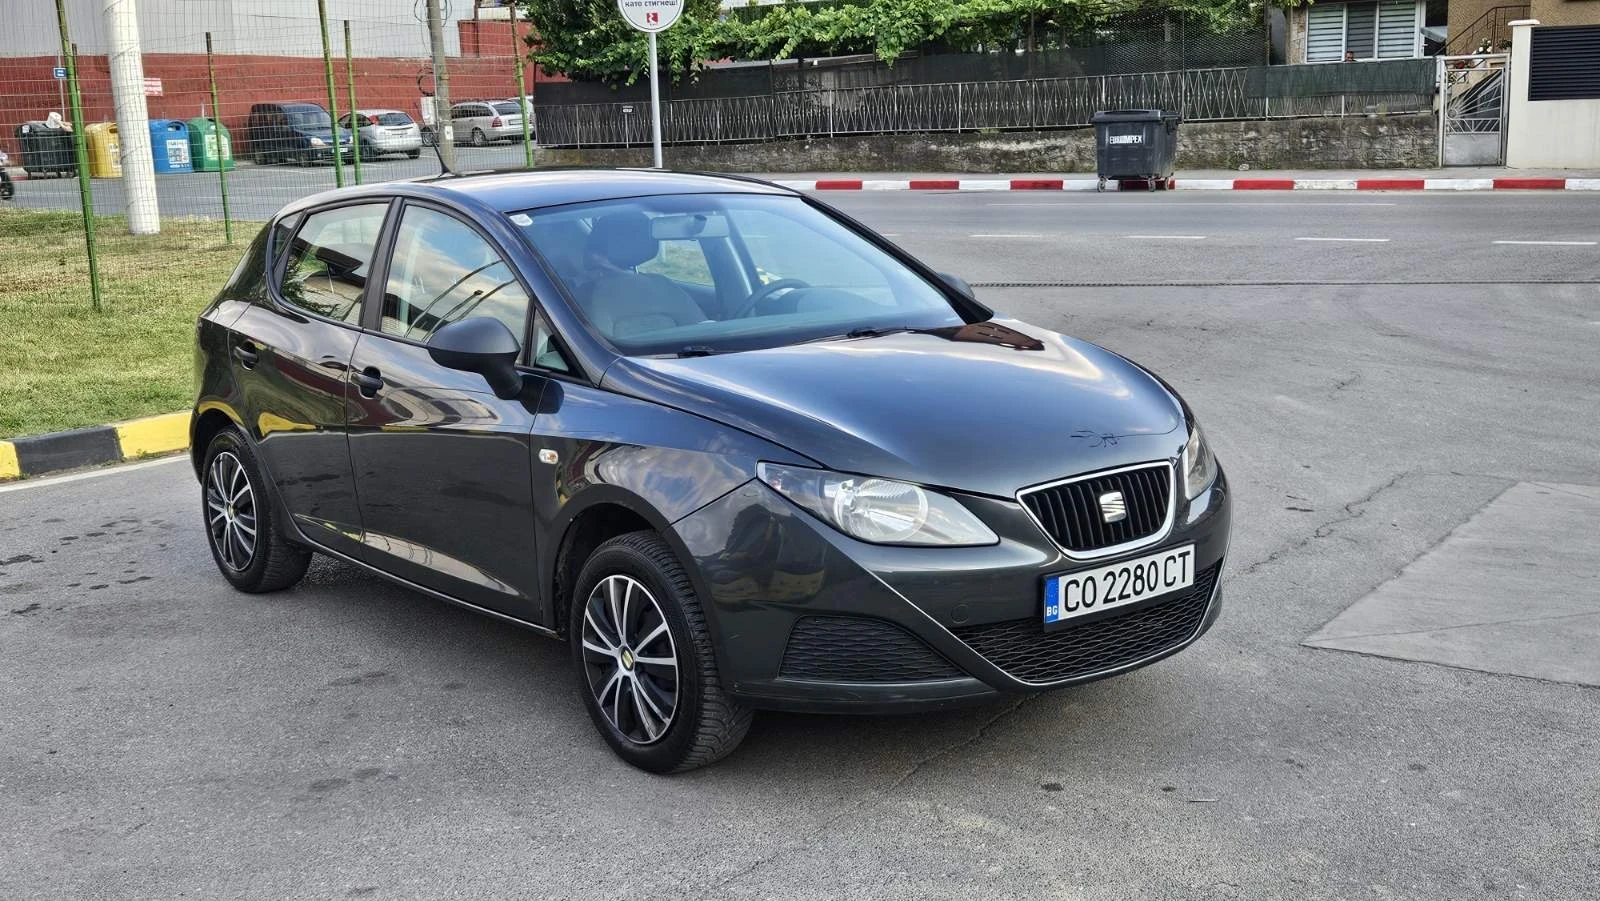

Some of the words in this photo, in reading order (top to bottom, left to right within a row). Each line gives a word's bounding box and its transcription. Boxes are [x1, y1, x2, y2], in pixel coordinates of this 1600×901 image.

[1064, 575, 1097, 612] CO
[1102, 560, 1159, 605] 2280
[1163, 550, 1191, 588] CT
[1046, 605, 1058, 617] BG
